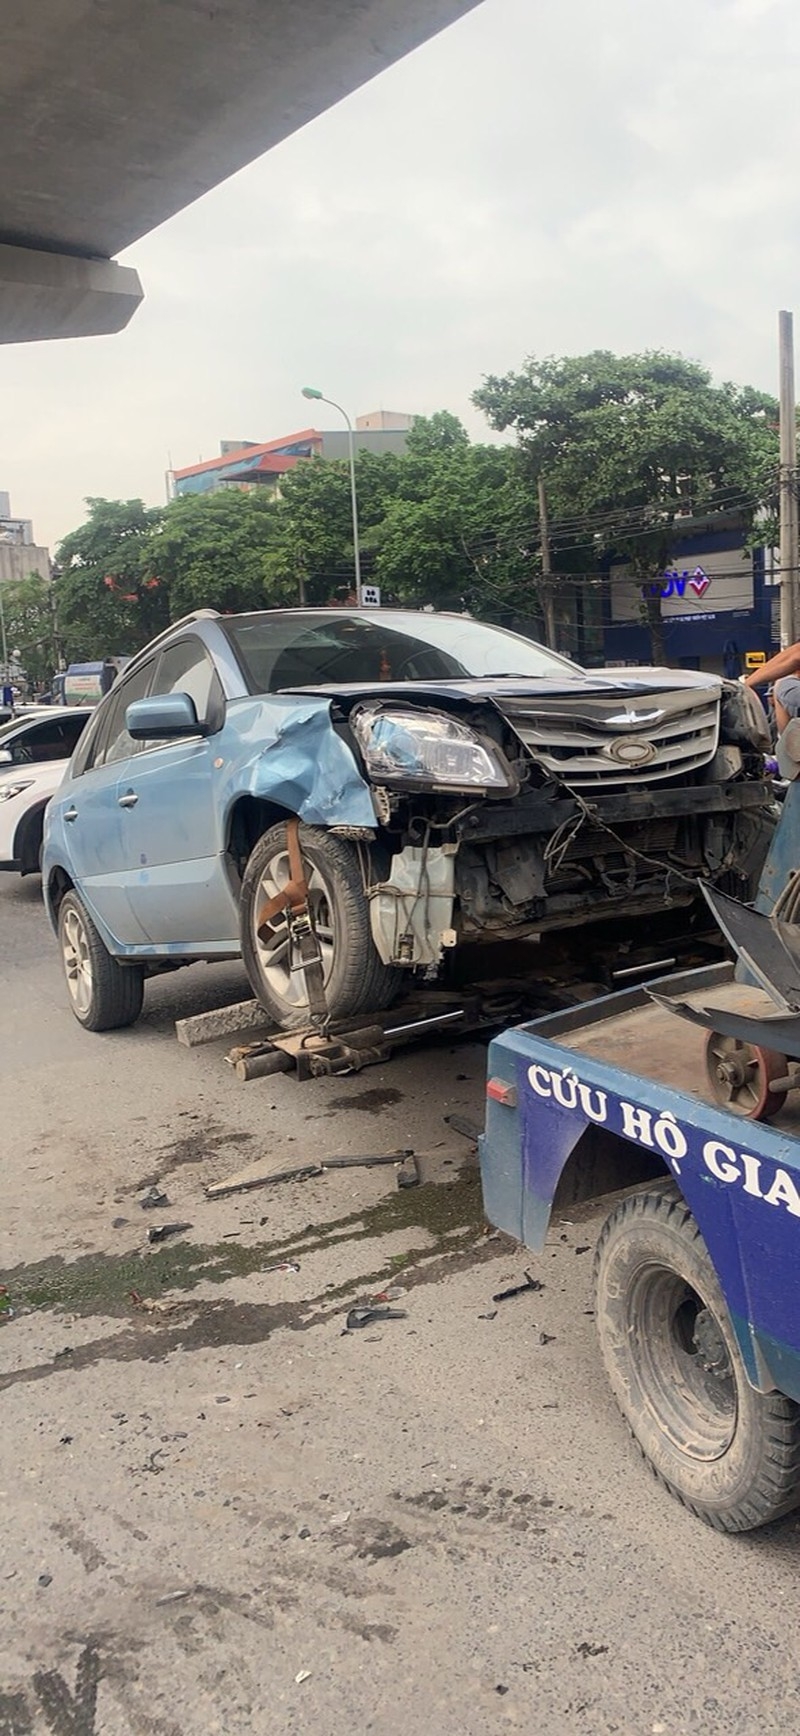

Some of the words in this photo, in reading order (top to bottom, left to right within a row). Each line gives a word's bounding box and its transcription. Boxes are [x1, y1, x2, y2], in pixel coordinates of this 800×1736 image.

[527, 1064, 608, 1123] CỨU
[619, 1102, 688, 1175] HỘ
[702, 1140, 800, 1218] GIA
